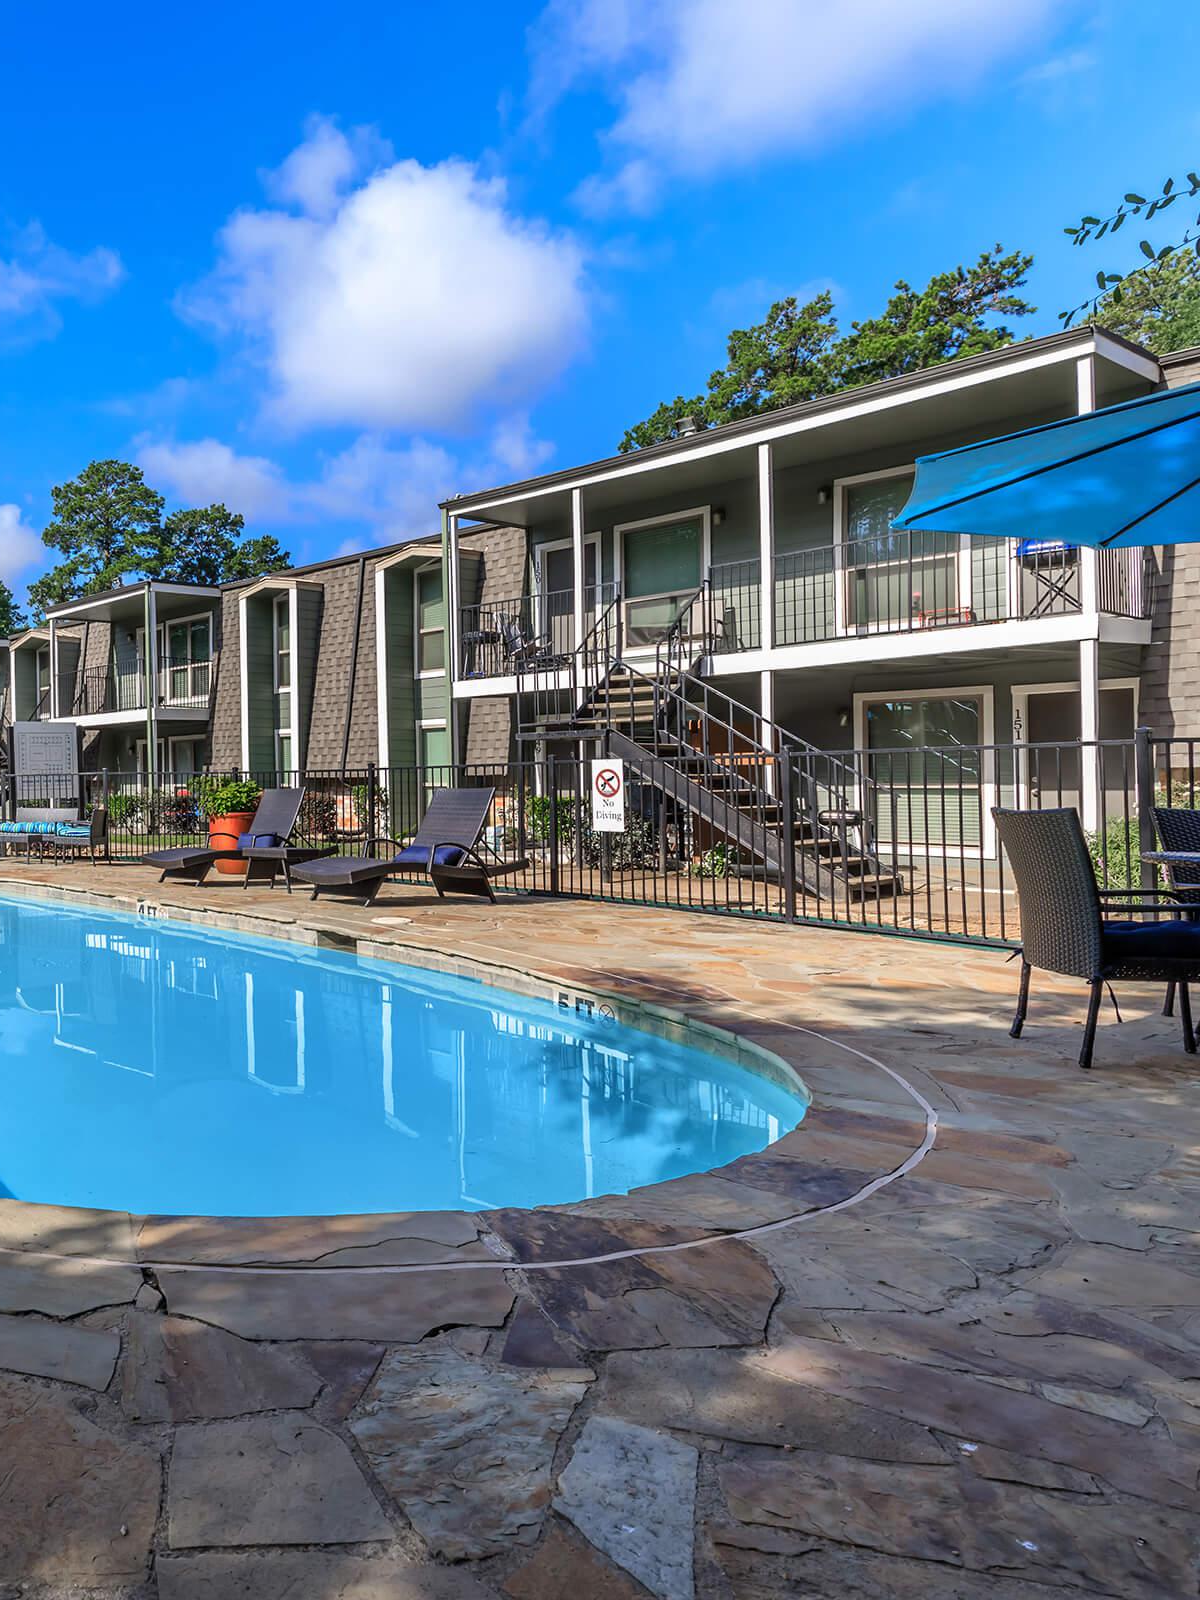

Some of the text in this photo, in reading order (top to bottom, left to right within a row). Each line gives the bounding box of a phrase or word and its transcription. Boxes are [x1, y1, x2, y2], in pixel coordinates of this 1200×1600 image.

[1014, 709, 1022, 740] 151
[602, 799, 615, 808] No
[596, 811, 622, 822] Diving
[147, 905, 157, 916] FT
[558, 991, 595, 1015] 5 FT
